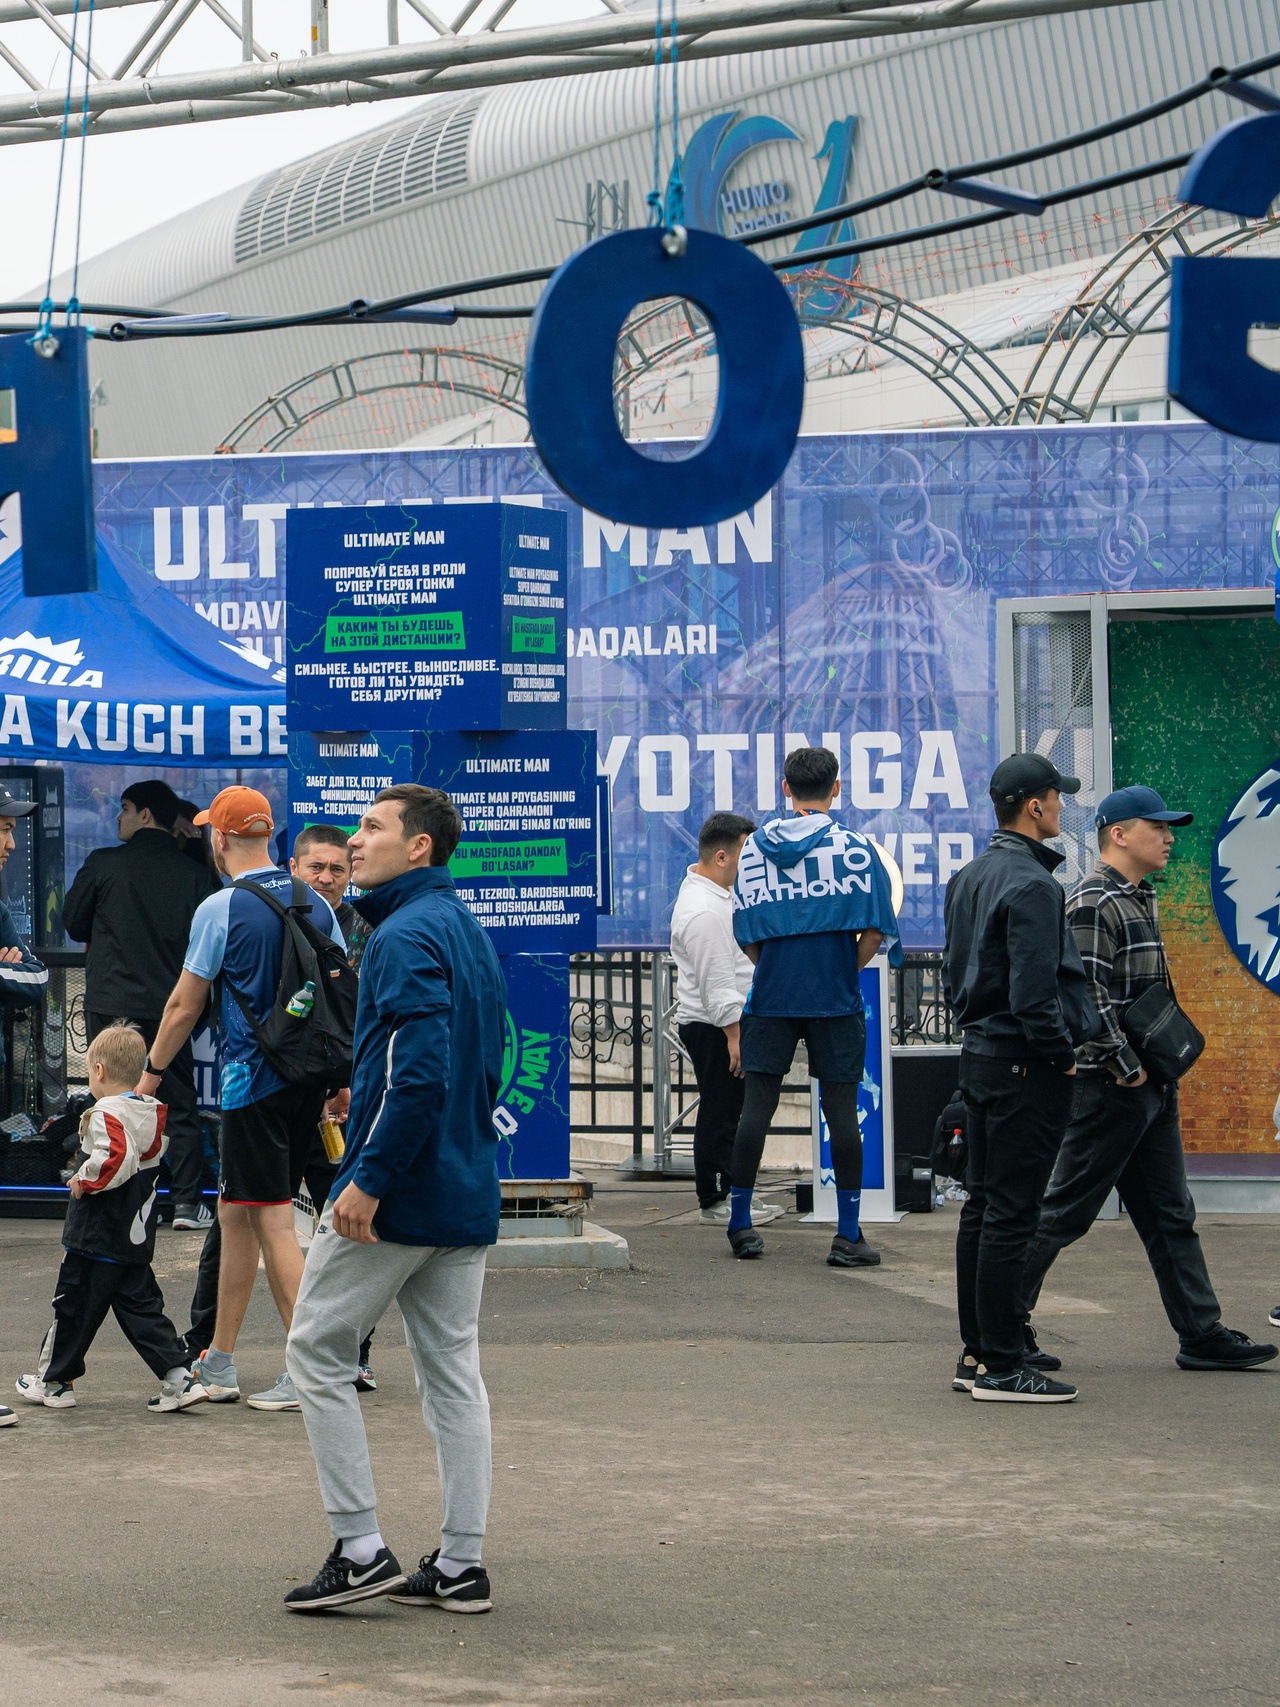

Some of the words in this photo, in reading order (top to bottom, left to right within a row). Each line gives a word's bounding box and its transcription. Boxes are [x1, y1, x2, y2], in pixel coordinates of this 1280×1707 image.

[720, 181, 788, 216] HUMO
[344, 532, 410, 548] ULTIMATE
[414, 530, 445, 545] MAN
[324, 563, 386, 579] ПОПРОБУЙ
[389, 565, 419, 577] СЕБЯ
[422, 564, 430, 576] В
[433, 563, 466, 576] РОЛИ
[335, 580, 373, 592] СУПЕР
[376, 579, 413, 591] ГЕРОЯ
[416, 577, 455, 590] ГОНКИ
[353, 592, 408, 606] ULTIMATE
[411, 592, 437, 604] MAN
[337, 621, 378, 633] КАКИМ
[381, 621, 399, 632] ТЫ
[402, 619, 454, 632] БУДЕШЬ
[331, 636, 347, 647] НА
[349, 633, 379, 646] ЭТОЙ
[382, 633, 461, 647] ДИСТАНЦИИ?
[294, 663, 351, 676] СИЛЬНЕЕ.
[353, 662, 412, 674] БЫСТРЕЕ.
[414, 660, 500, 673] ВЫНОСЛИВЕЕ.
[329, 676, 365, 688] ГОТОВ
[368, 675, 385, 688] ЛИ
[388, 675, 406, 687] ТЫ
[409, 674, 464, 688] УВИДЕТЬ
[351, 690, 381, 702] СЕБЯ
[384, 688, 442, 702] ДРУГИМ?
[56, 698, 205, 755] KUCH
[319, 743, 358, 757] ULTIMATE
[360, 743, 379, 757] MAN
[466, 759, 521, 773] ULTIMATE
[524, 758, 550, 772] MAN
[306, 776, 327, 787] ЗАБЕГ
[329, 776, 344, 788] ДЛЯ
[345, 776, 360, 789] ТЕХ,
[361, 776, 375, 788] КТО
[376, 776, 393, 788] УЖЕ
[449, 792, 485, 805] TIMATE
[488, 792, 509, 804] MAN
[511, 791, 576, 803] POYGASINING
[293, 802, 318, 814] ТЕПЕРЬ
[463, 806, 494, 818] SUPER
[497, 805, 553, 818] QAHRAMONI
[522, 818, 551, 830] SINAB
[455, 848, 467, 859] BU
[470, 847, 522, 858] MASOFADA
[524, 846, 561, 858] QANDAY
[479, 888, 518, 901] TEZROQ.
[520, 885, 596, 899] BARDOSHLIROQ.
[732, 878, 848, 914] ARATHON
[495, 900, 565, 914] BOSHQALARGA
[507, 913, 580, 926] TAYYORMISAN?
[517, 1028, 551, 1090] MAY
[505, 1088, 535, 1114] 3
